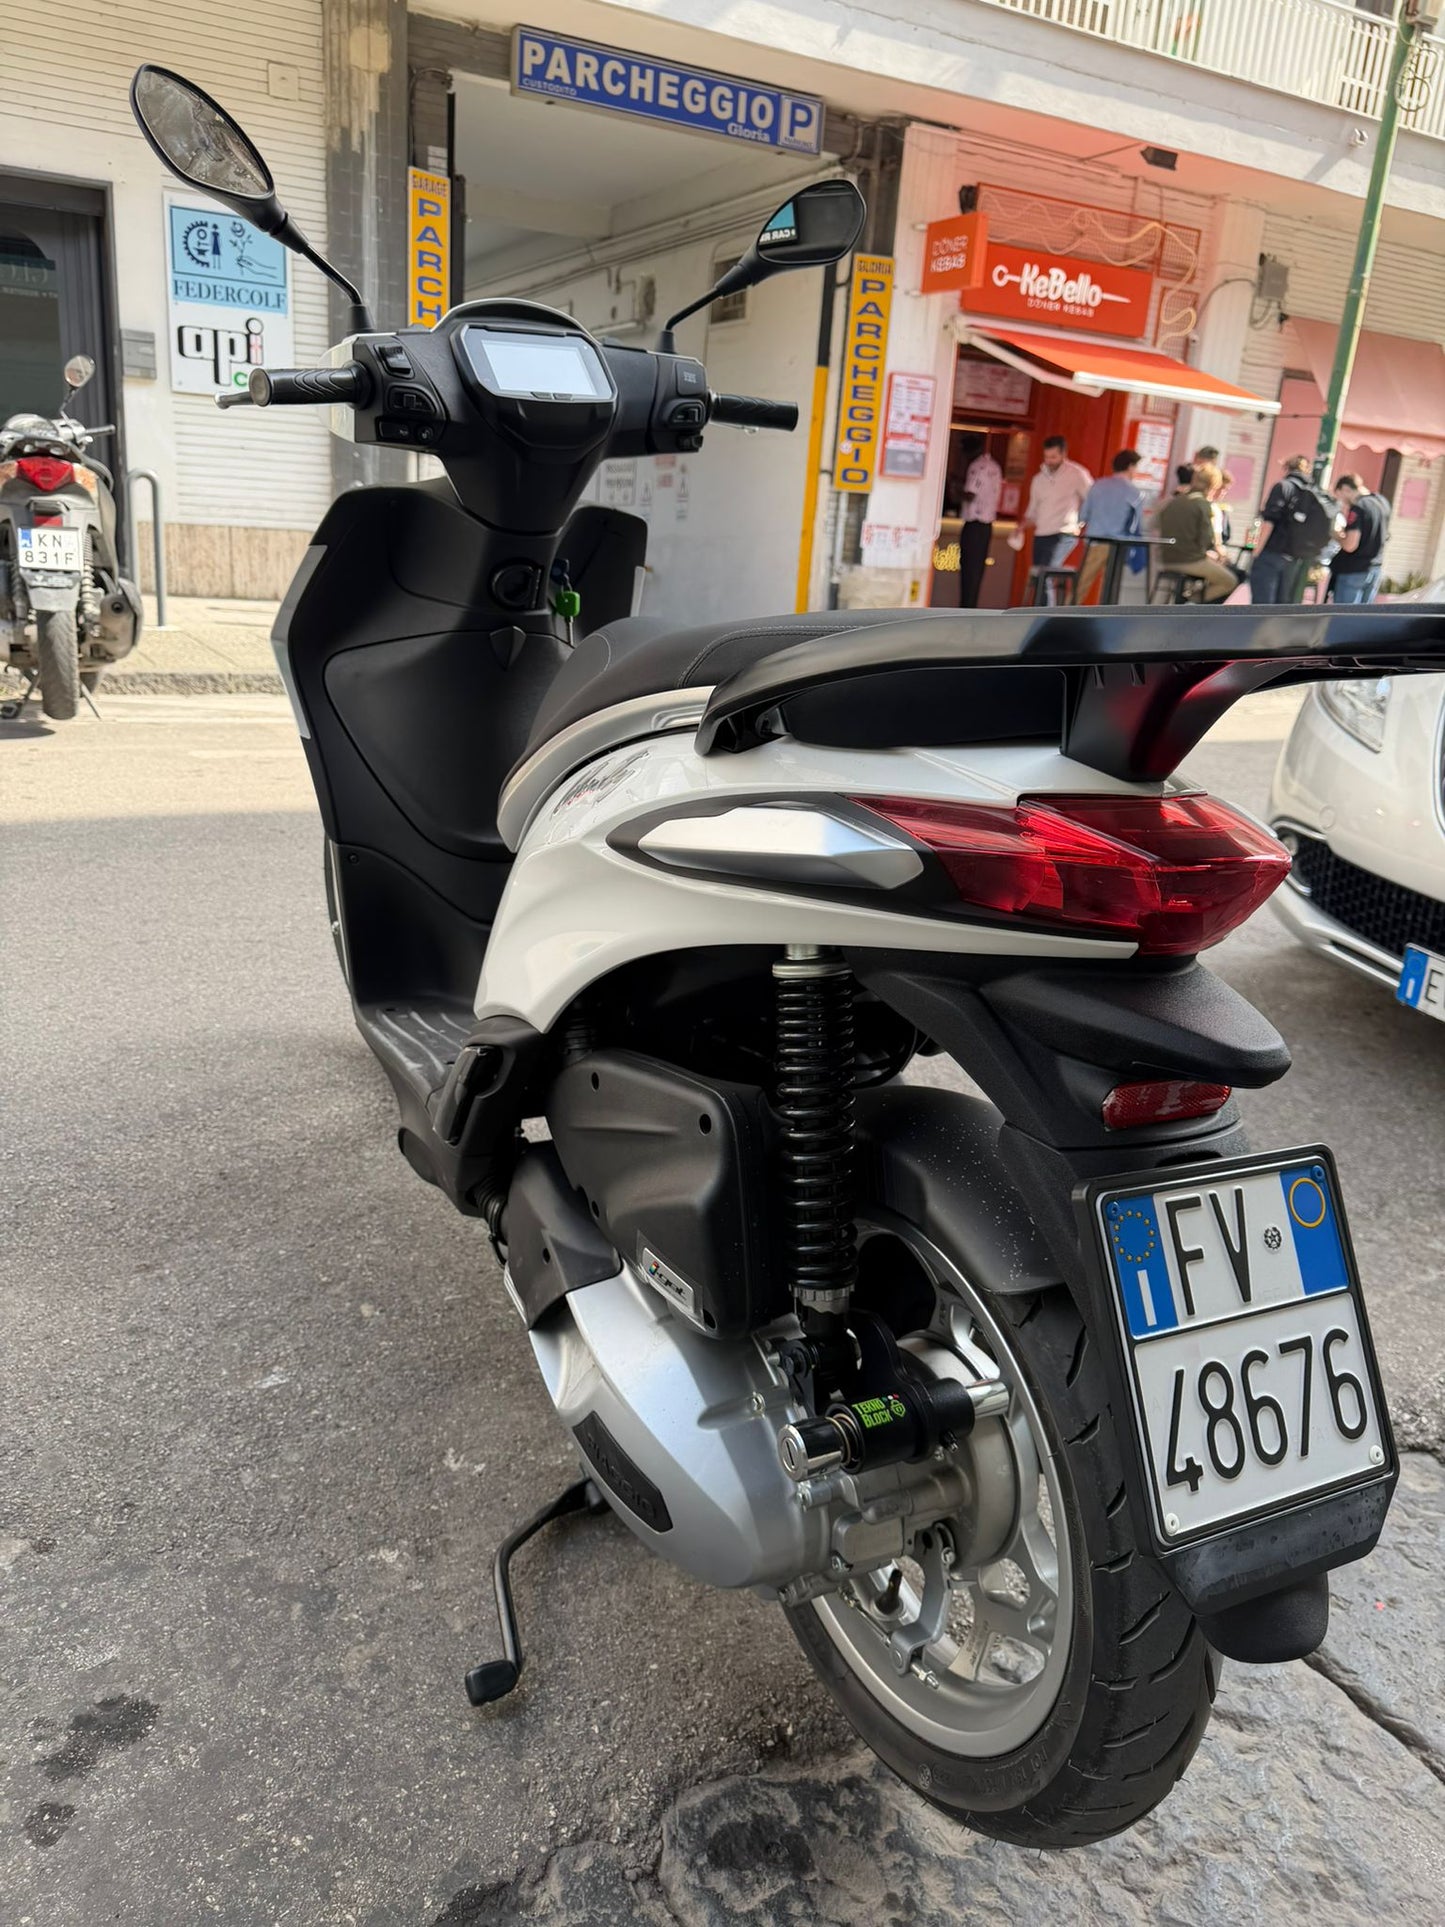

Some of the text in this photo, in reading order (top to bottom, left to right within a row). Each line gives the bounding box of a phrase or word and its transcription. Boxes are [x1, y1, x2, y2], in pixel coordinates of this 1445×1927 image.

[521, 77, 578, 97] CUSTODITO
[522, 39, 774, 129] PARCHEGGIO
[727, 121, 771, 143] Gloria
[788, 98, 812, 138] P
[174, 280, 286, 311] FEDERCOLF
[1019, 262, 1103, 308] KeBello
[178, 317, 264, 386] api
[841, 279, 886, 484] PARCHEGGIO
[1424, 968, 1445, 1005] E
[1164, 1186, 1253, 1317] FV
[851, 1397, 886, 1415] TEKNO
[860, 1408, 894, 1429] BLOCK
[1165, 1327, 1368, 1492] 48676
